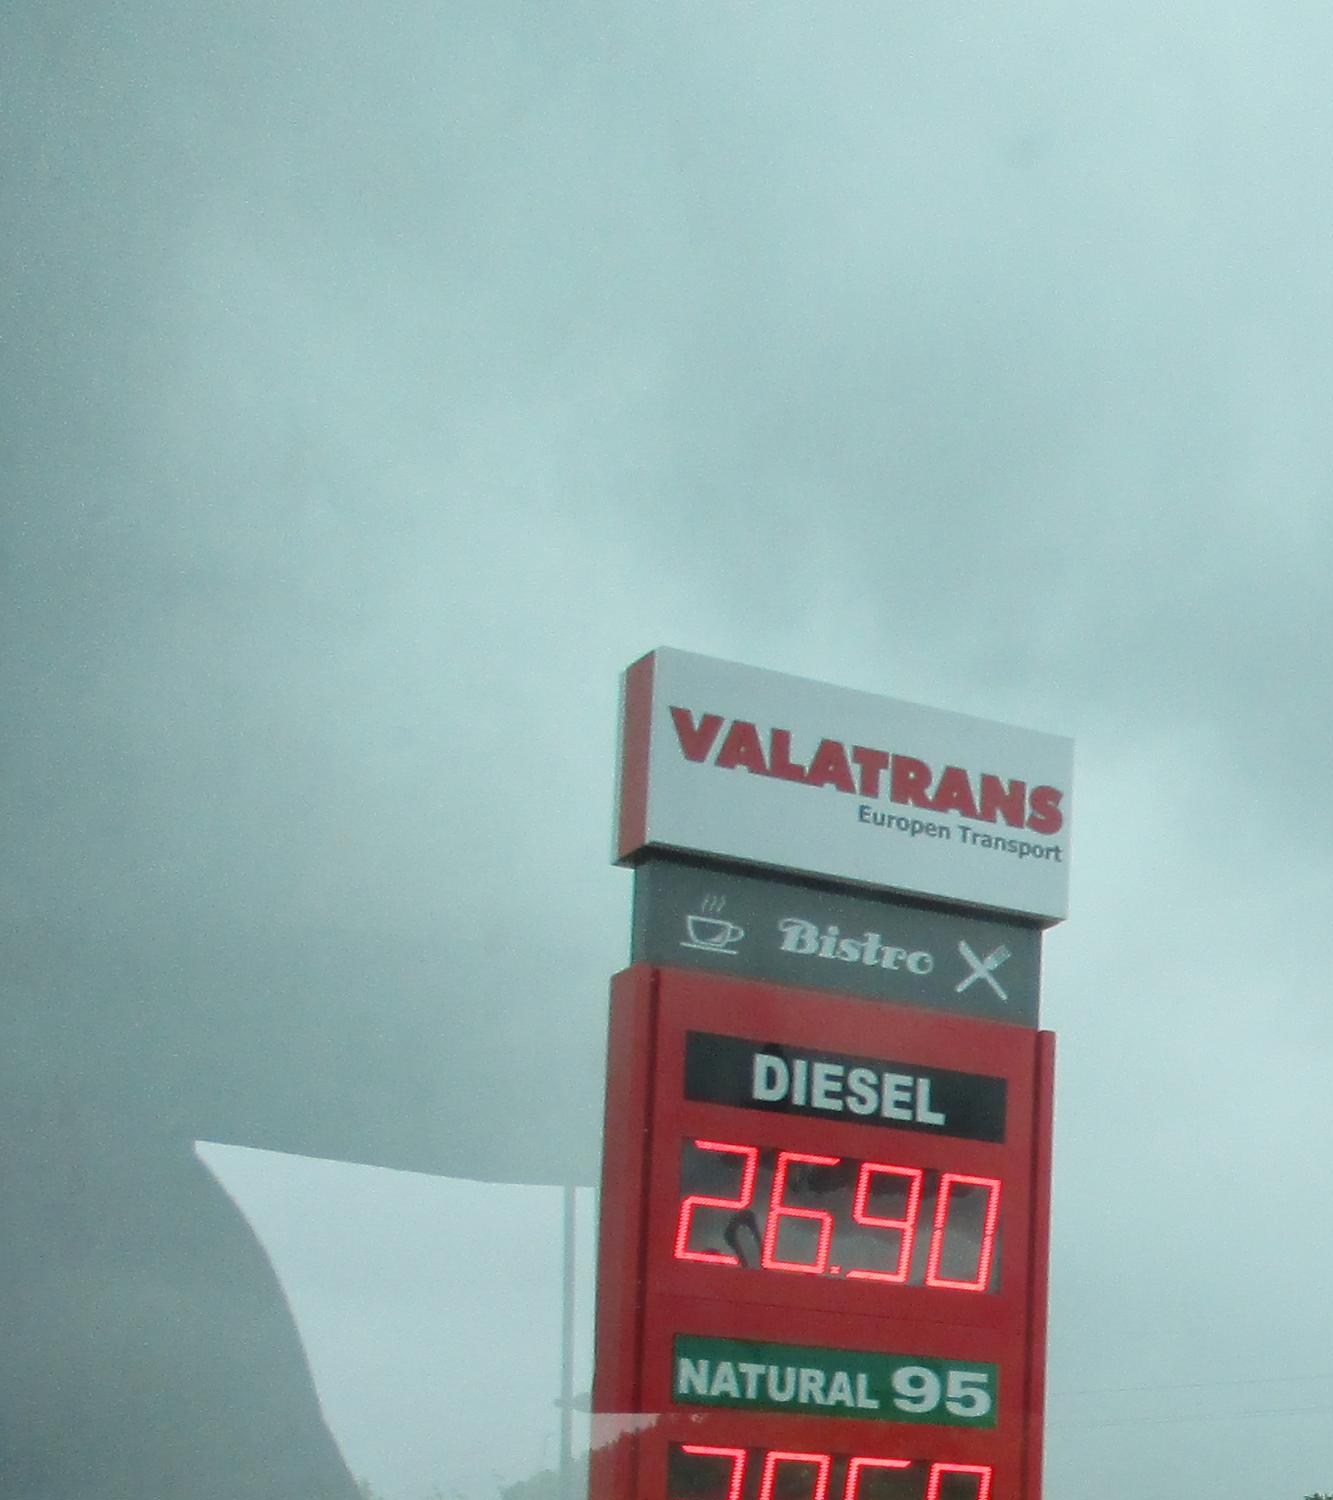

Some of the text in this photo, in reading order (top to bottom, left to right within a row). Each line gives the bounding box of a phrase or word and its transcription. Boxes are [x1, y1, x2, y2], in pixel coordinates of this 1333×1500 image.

[669, 705, 1063, 835] VALATRANS
[858, 805, 1063, 862] Europen Transport
[778, 917, 934, 974] Bistro
[752, 1052, 945, 1126] DIESEL
[674, 1139, 1002, 1292] 26.90
[677, 1357, 991, 1418] NATURAL 95
